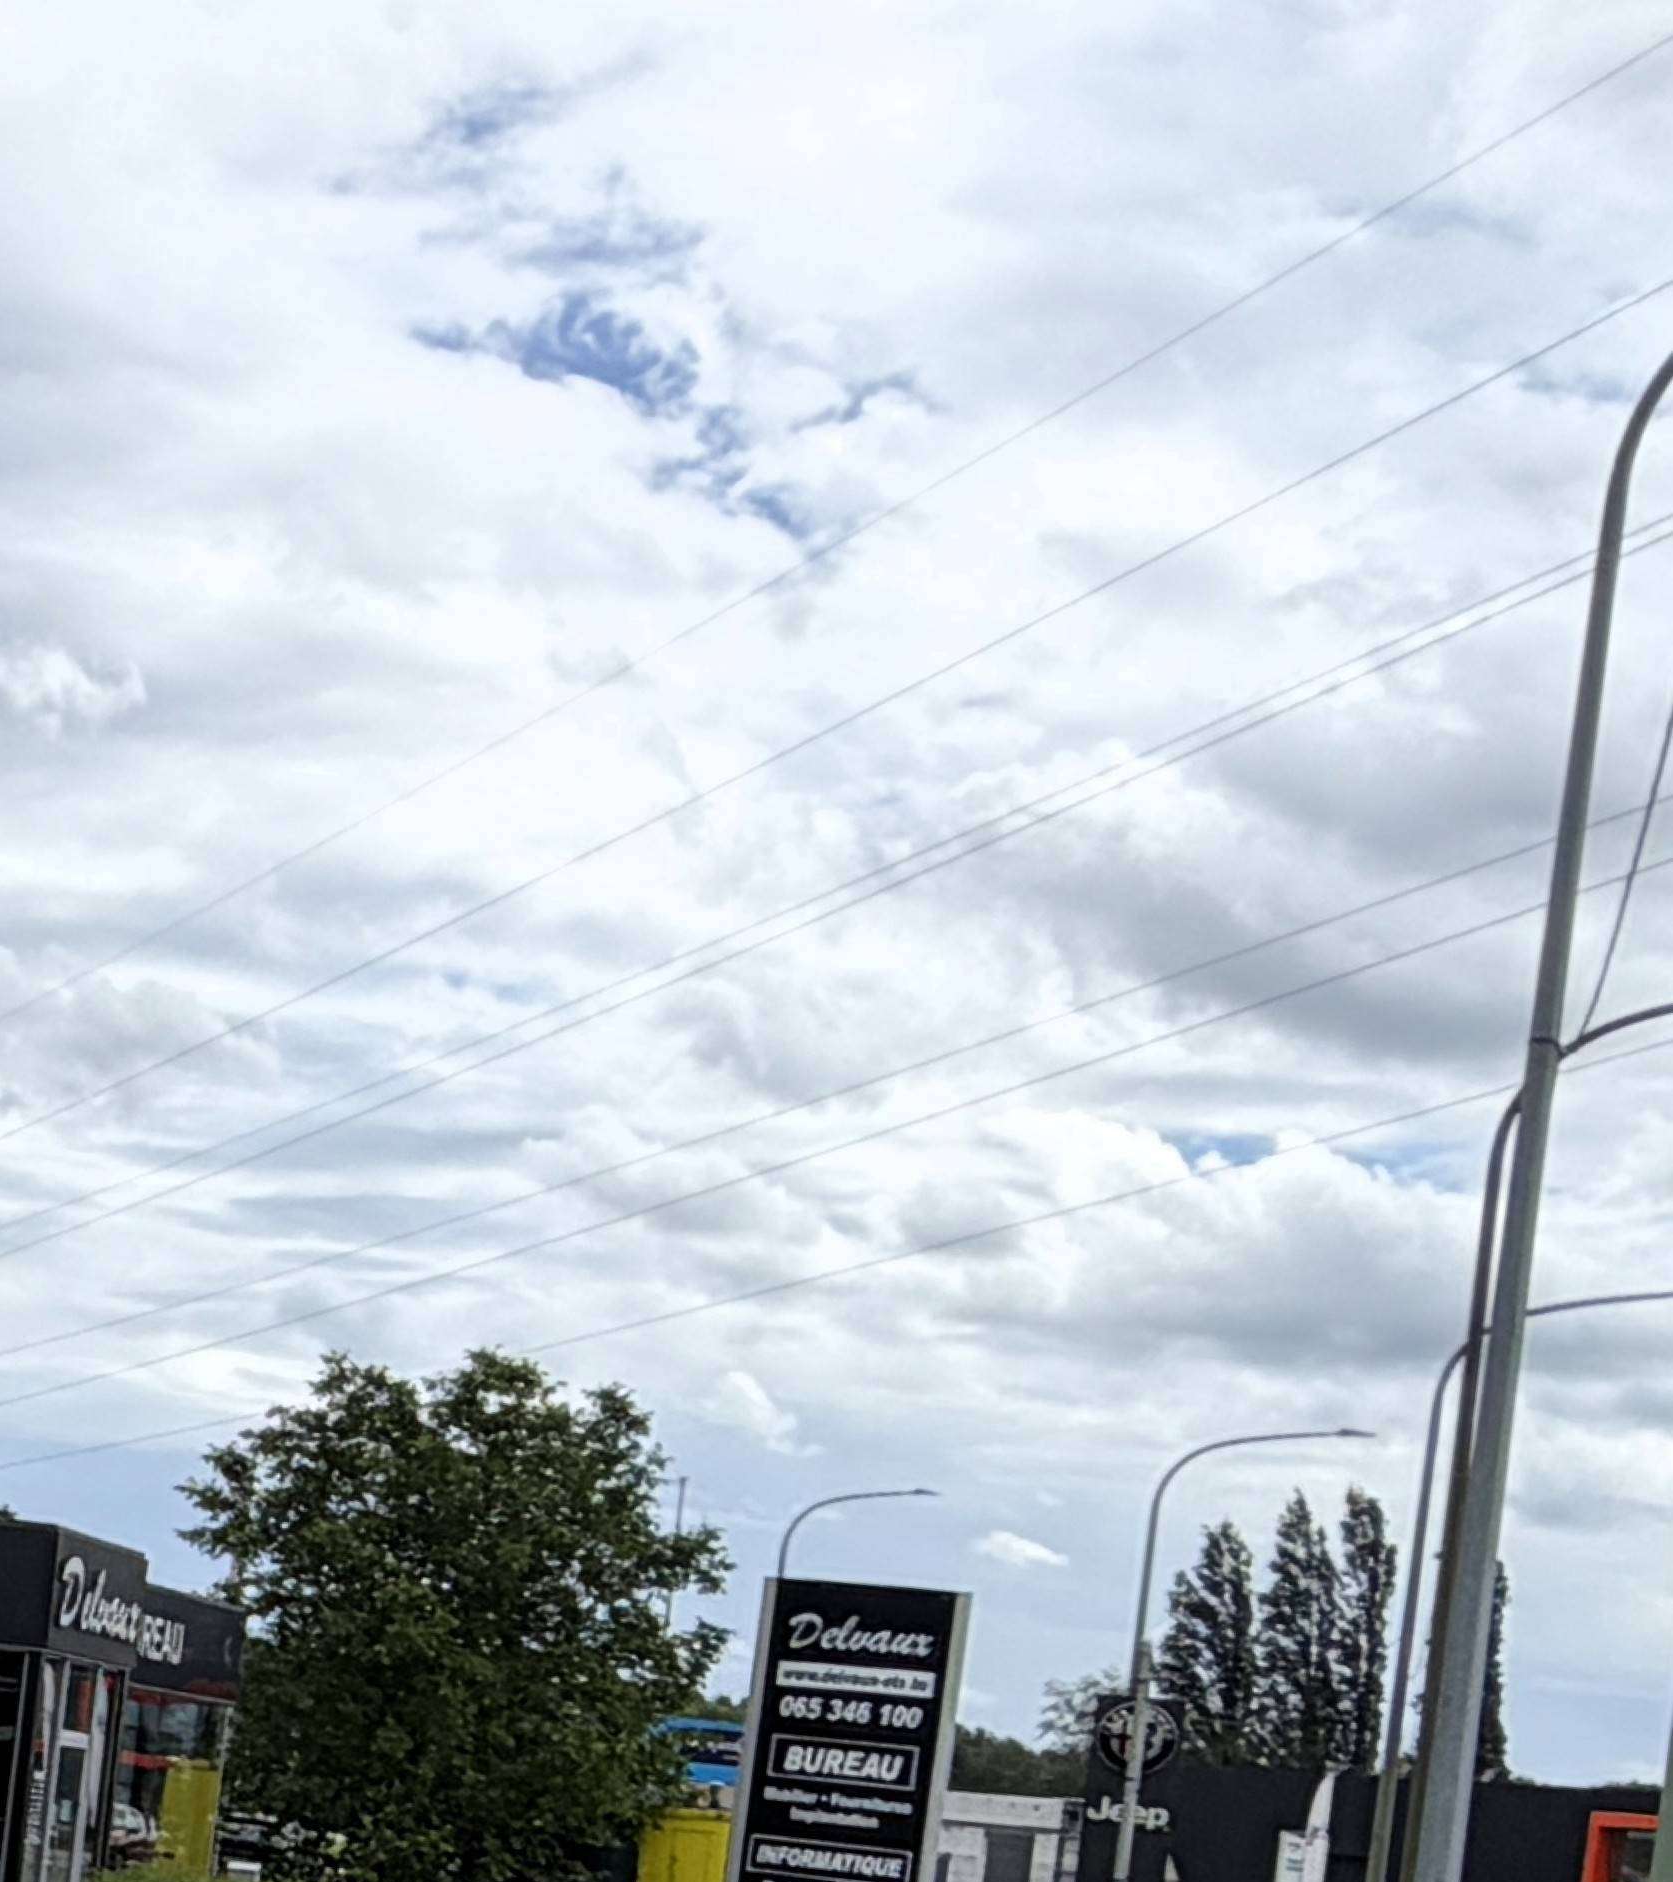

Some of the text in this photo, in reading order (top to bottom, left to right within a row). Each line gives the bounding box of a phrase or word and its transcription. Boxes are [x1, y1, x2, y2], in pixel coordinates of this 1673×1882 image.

[138, 1614, 186, 1666] REAU
[788, 1612, 935, 1657] Delvaux
[779, 1695, 925, 1729] 065 346 100
[783, 1744, 905, 1782] BUREAU
[756, 1843, 905, 1879] INFORMATIQUE
